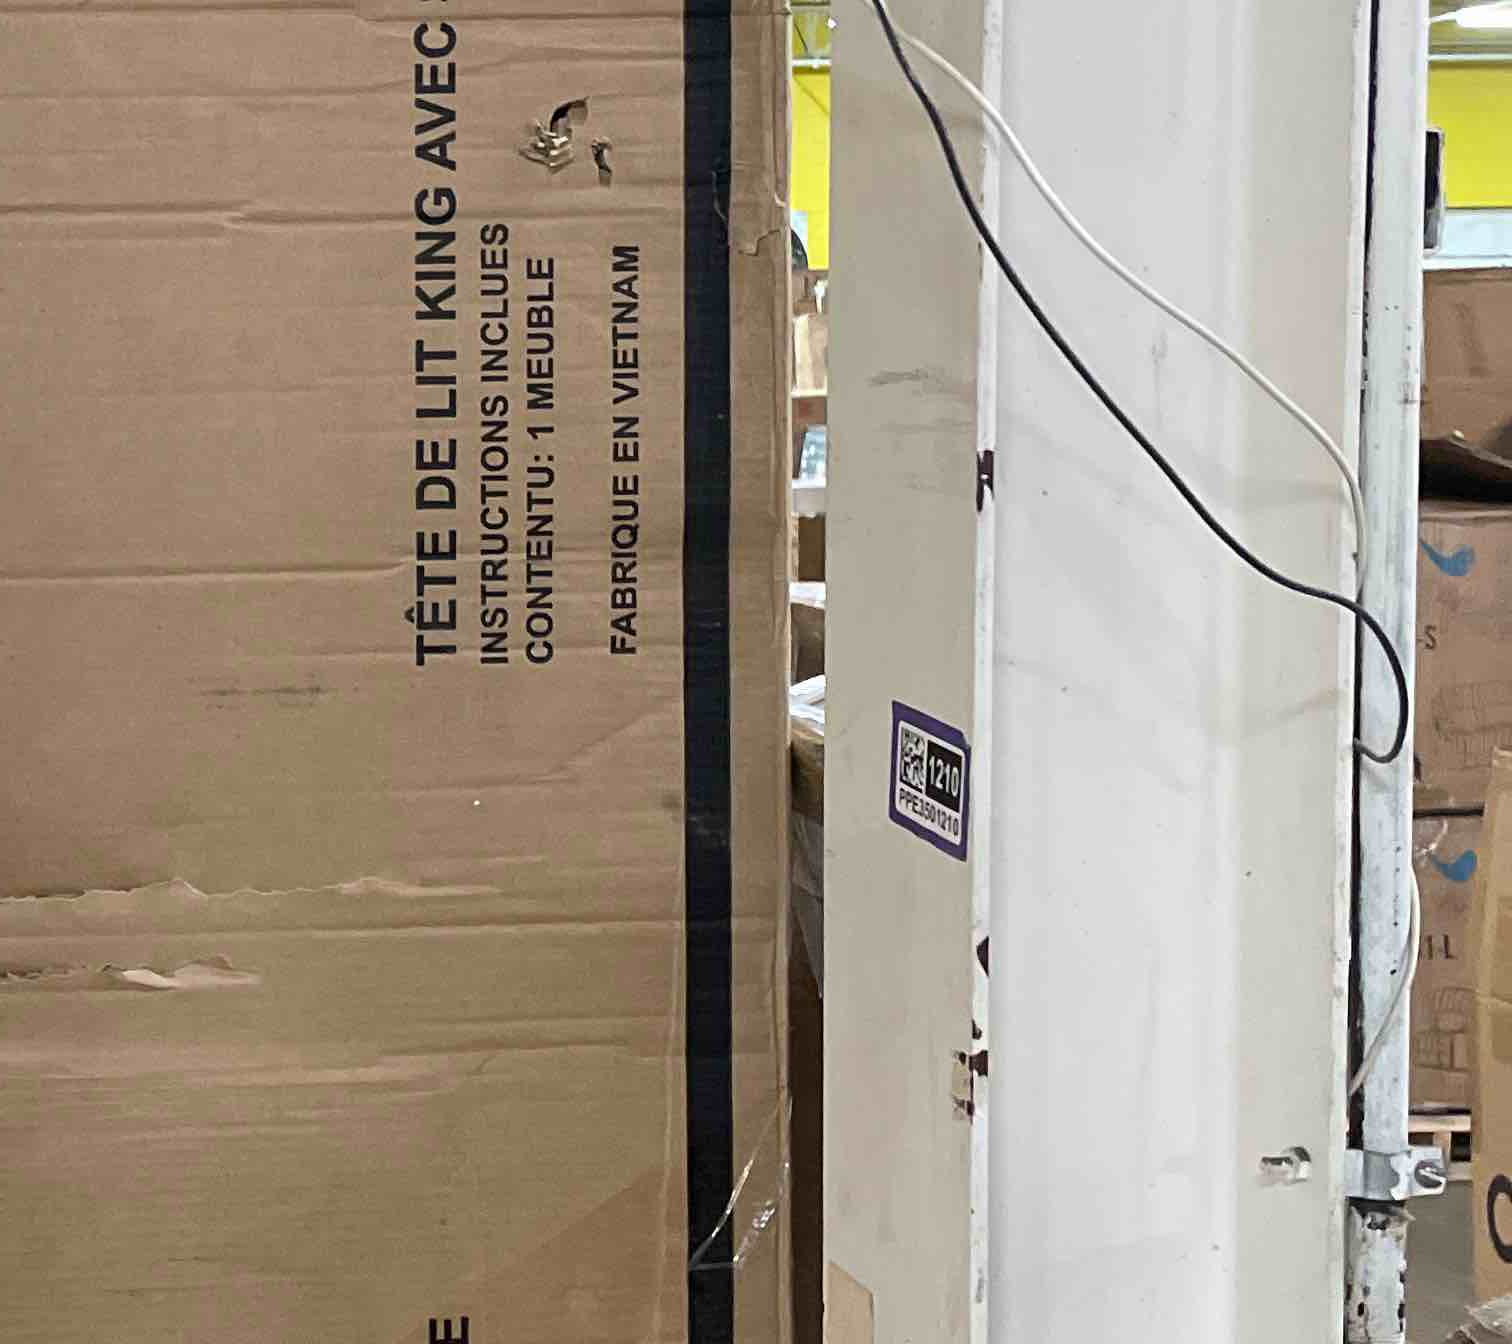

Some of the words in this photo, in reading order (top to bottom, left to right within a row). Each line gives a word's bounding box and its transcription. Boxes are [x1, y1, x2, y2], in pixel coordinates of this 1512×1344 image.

[414, 23, 456, 170] AVEC
[415, 188, 456, 319] KING
[481, 224, 508, 381] INCLUES
[416, 340, 456, 418] LIT
[527, 258, 553, 409] MEUBLE
[612, 246, 639, 404] VIETNAM
[416, 439, 456, 509] DE
[527, 427, 554, 439] 1
[613, 417, 639, 462] EN
[405, 530, 456, 666] TÊTE
[480, 396, 508, 664] INSTRUCTIONS
[526, 456, 554, 663] CONTENTU:
[611, 475, 639, 654] FABRIQUE
[929, 755, 960, 797] 1210
